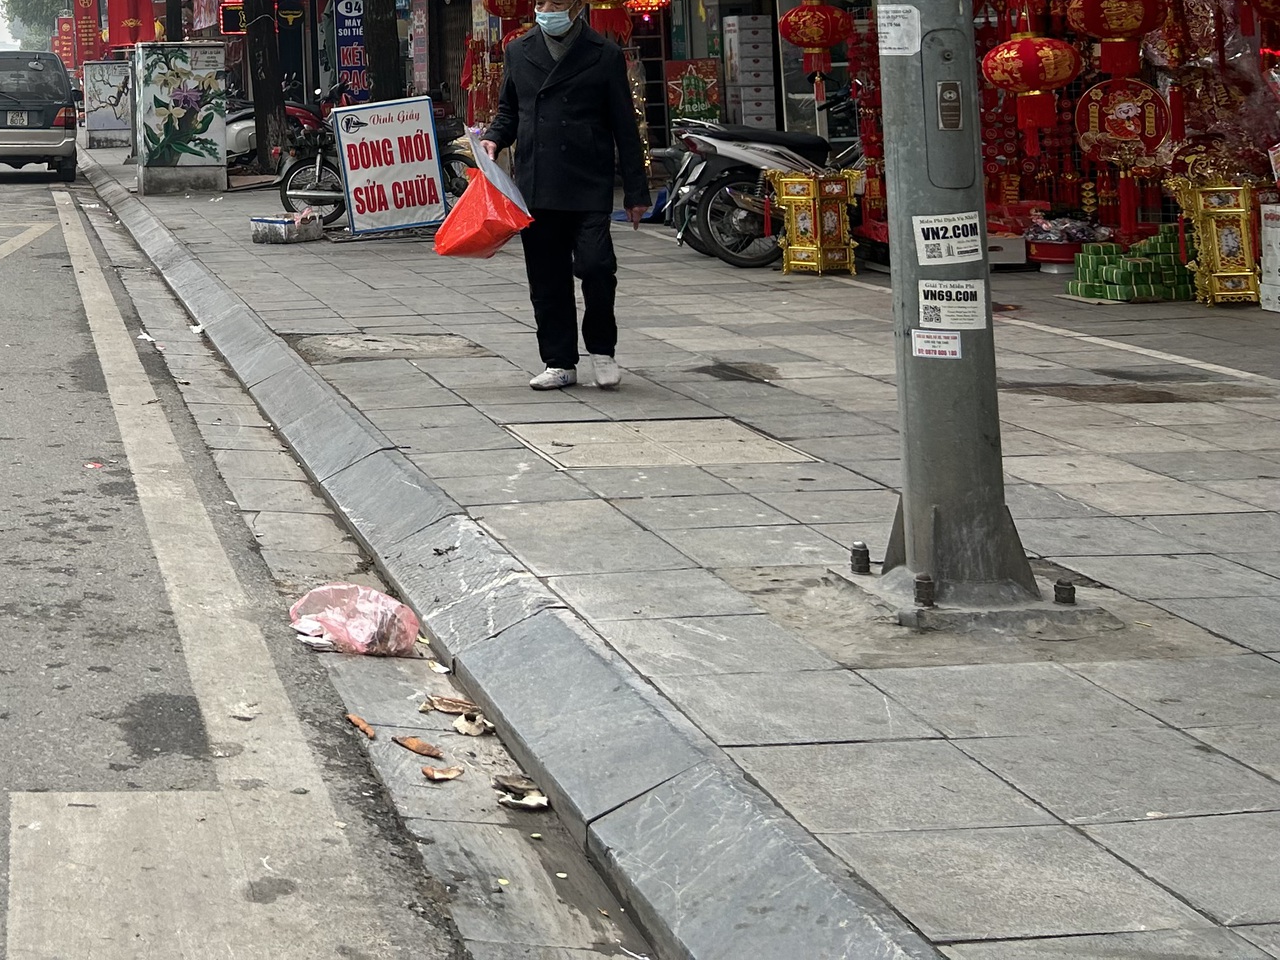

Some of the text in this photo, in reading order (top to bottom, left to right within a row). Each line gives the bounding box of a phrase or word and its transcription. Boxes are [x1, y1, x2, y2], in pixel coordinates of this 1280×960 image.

[345, 1, 362, 14] 94
[345, 18, 361, 27] MÁY
[338, 28, 351, 36] SOI
[369, 112, 394, 126] Vinh
[347, 129, 433, 171] ĐÓNG MỚI
[353, 174, 440, 215] SỬA CHỮA
[921, 222, 978, 240] VN2.COM
[923, 289, 978, 302] VN69.COM
